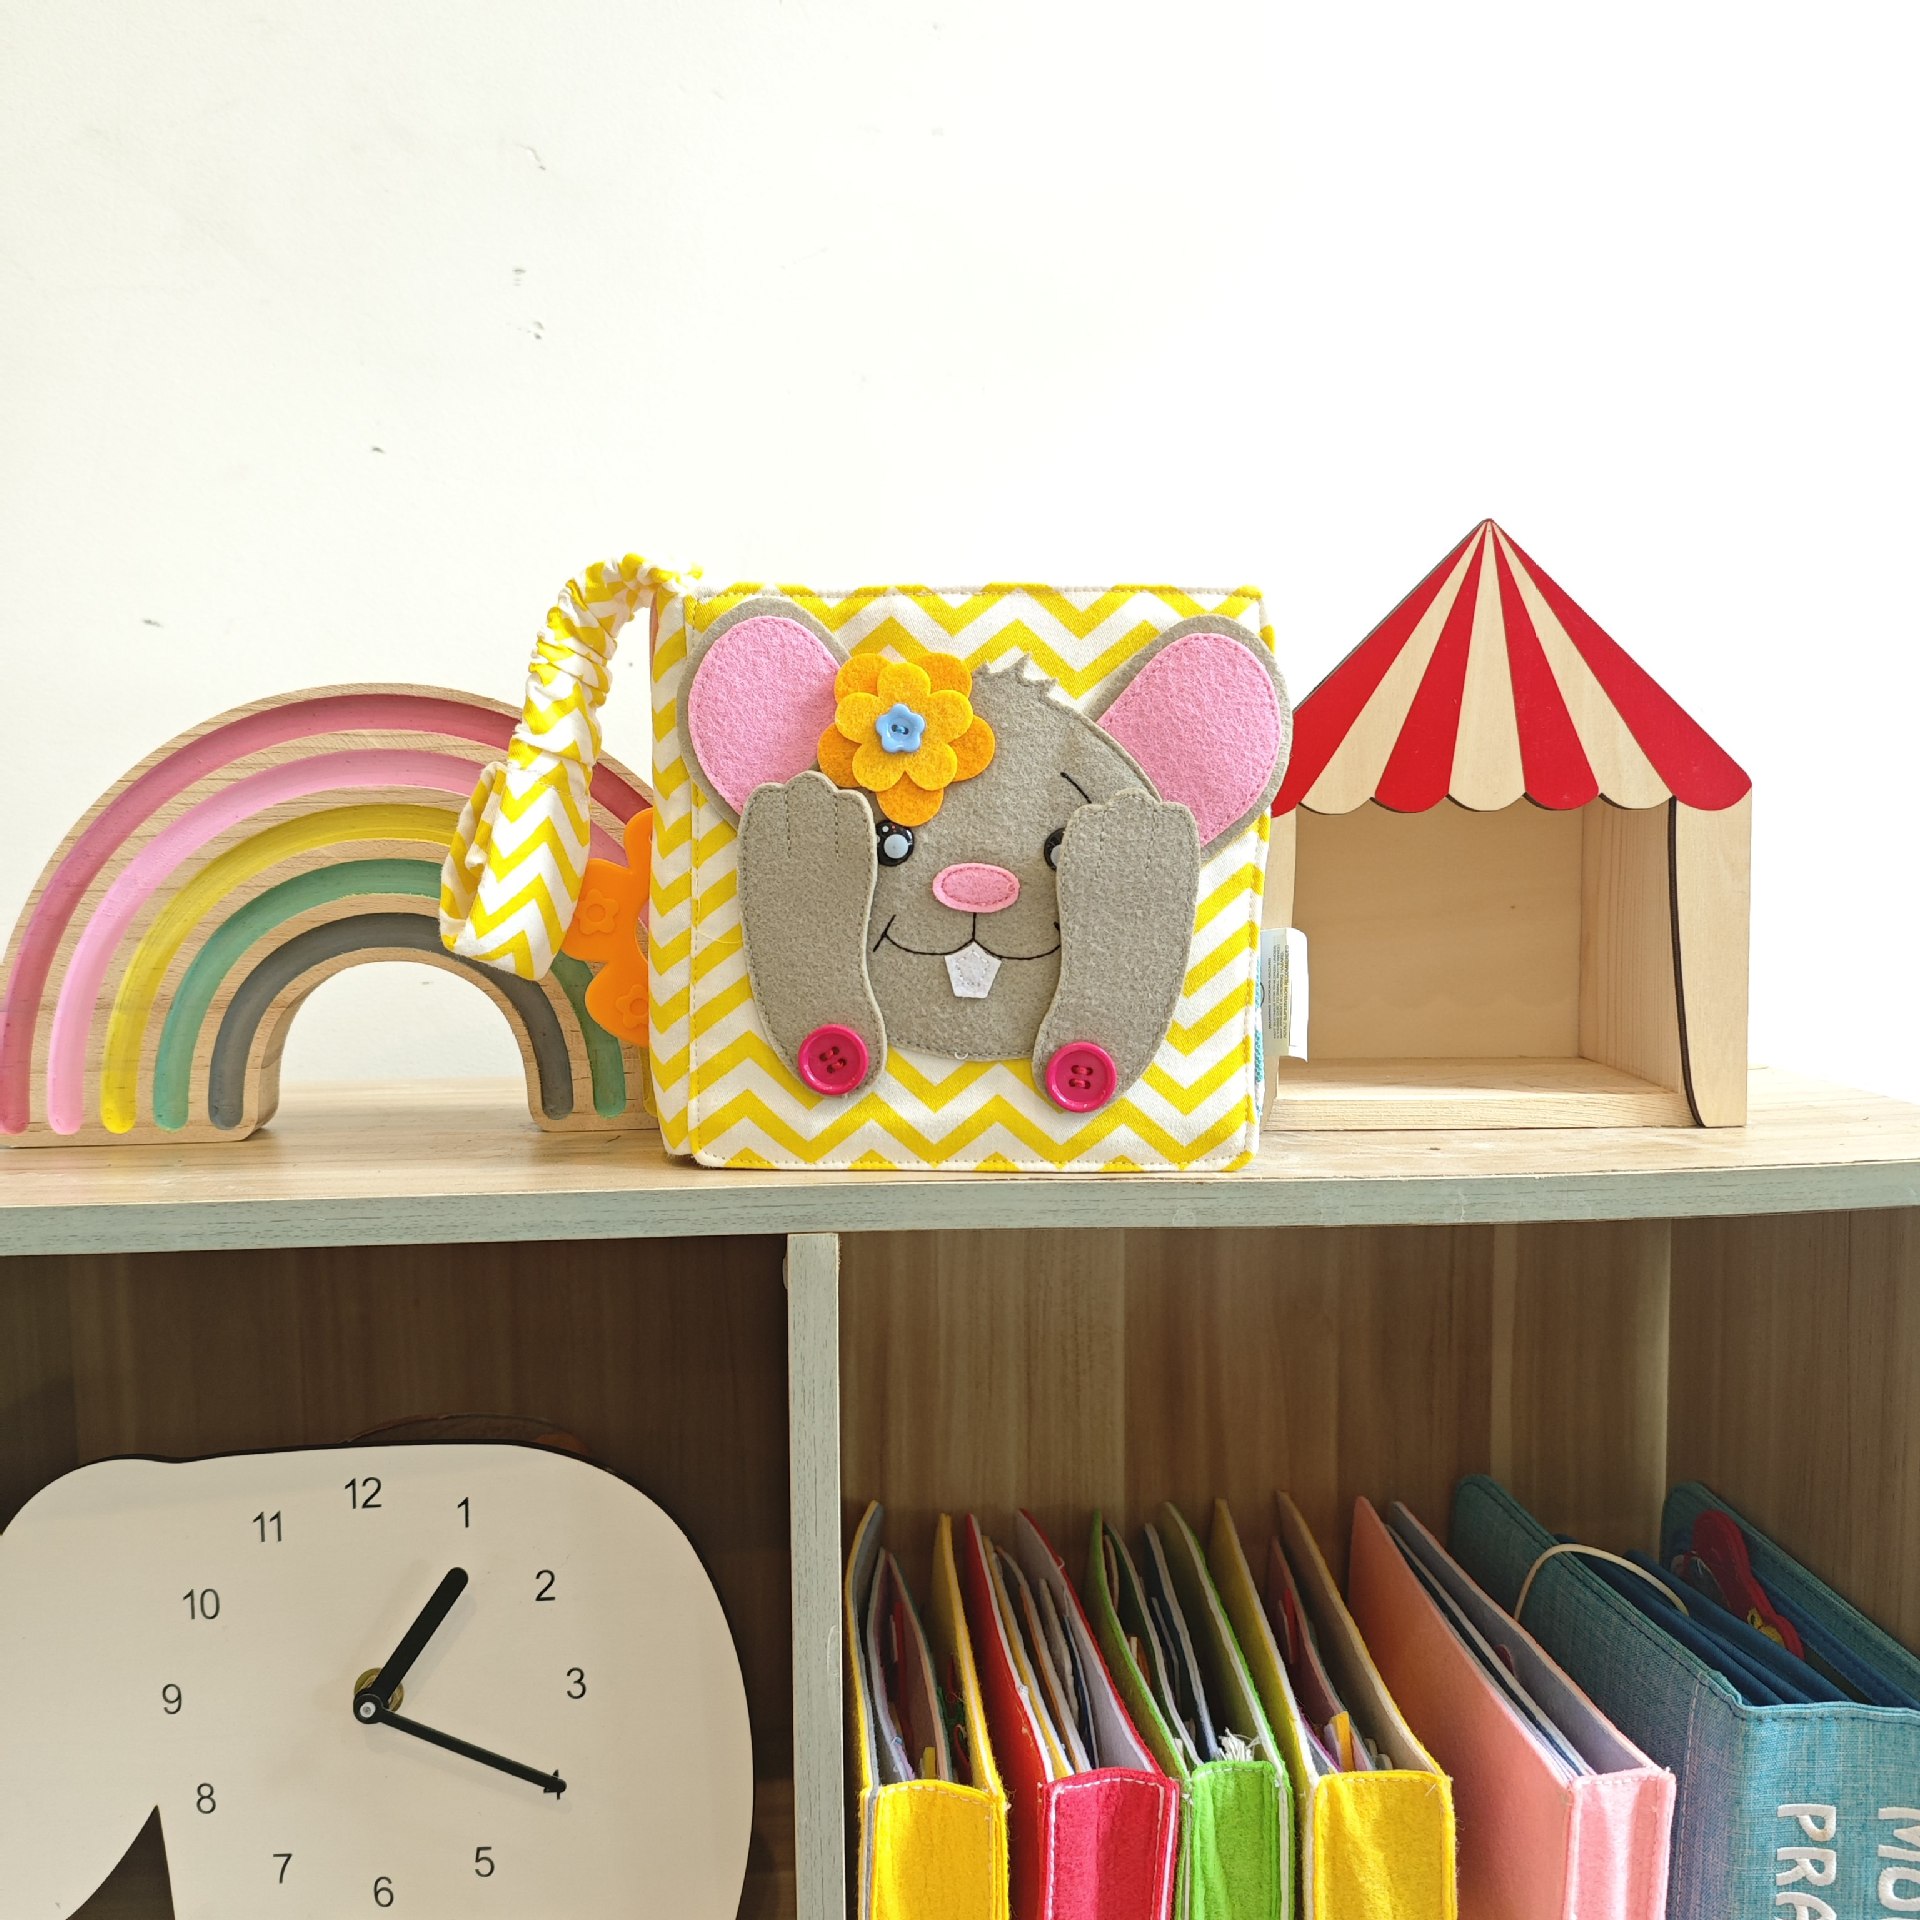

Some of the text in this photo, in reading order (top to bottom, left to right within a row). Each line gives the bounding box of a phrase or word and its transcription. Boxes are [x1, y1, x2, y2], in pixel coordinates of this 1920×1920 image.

[345, 1477, 381, 1509] 12
[253, 1511, 282, 1542] 11
[457, 1497, 469, 1527] 1
[535, 1570, 555, 1601] 2
[183, 1589, 220, 1619] 10
[566, 1668, 586, 1699] 3
[162, 1684, 181, 1714] 9
[197, 1783, 216, 1814] 8
[273, 1854, 293, 1884] 7
[475, 1847, 495, 1877] 5
[1878, 1806, 1920, 1920] MO
[374, 1877, 394, 1907] 6
